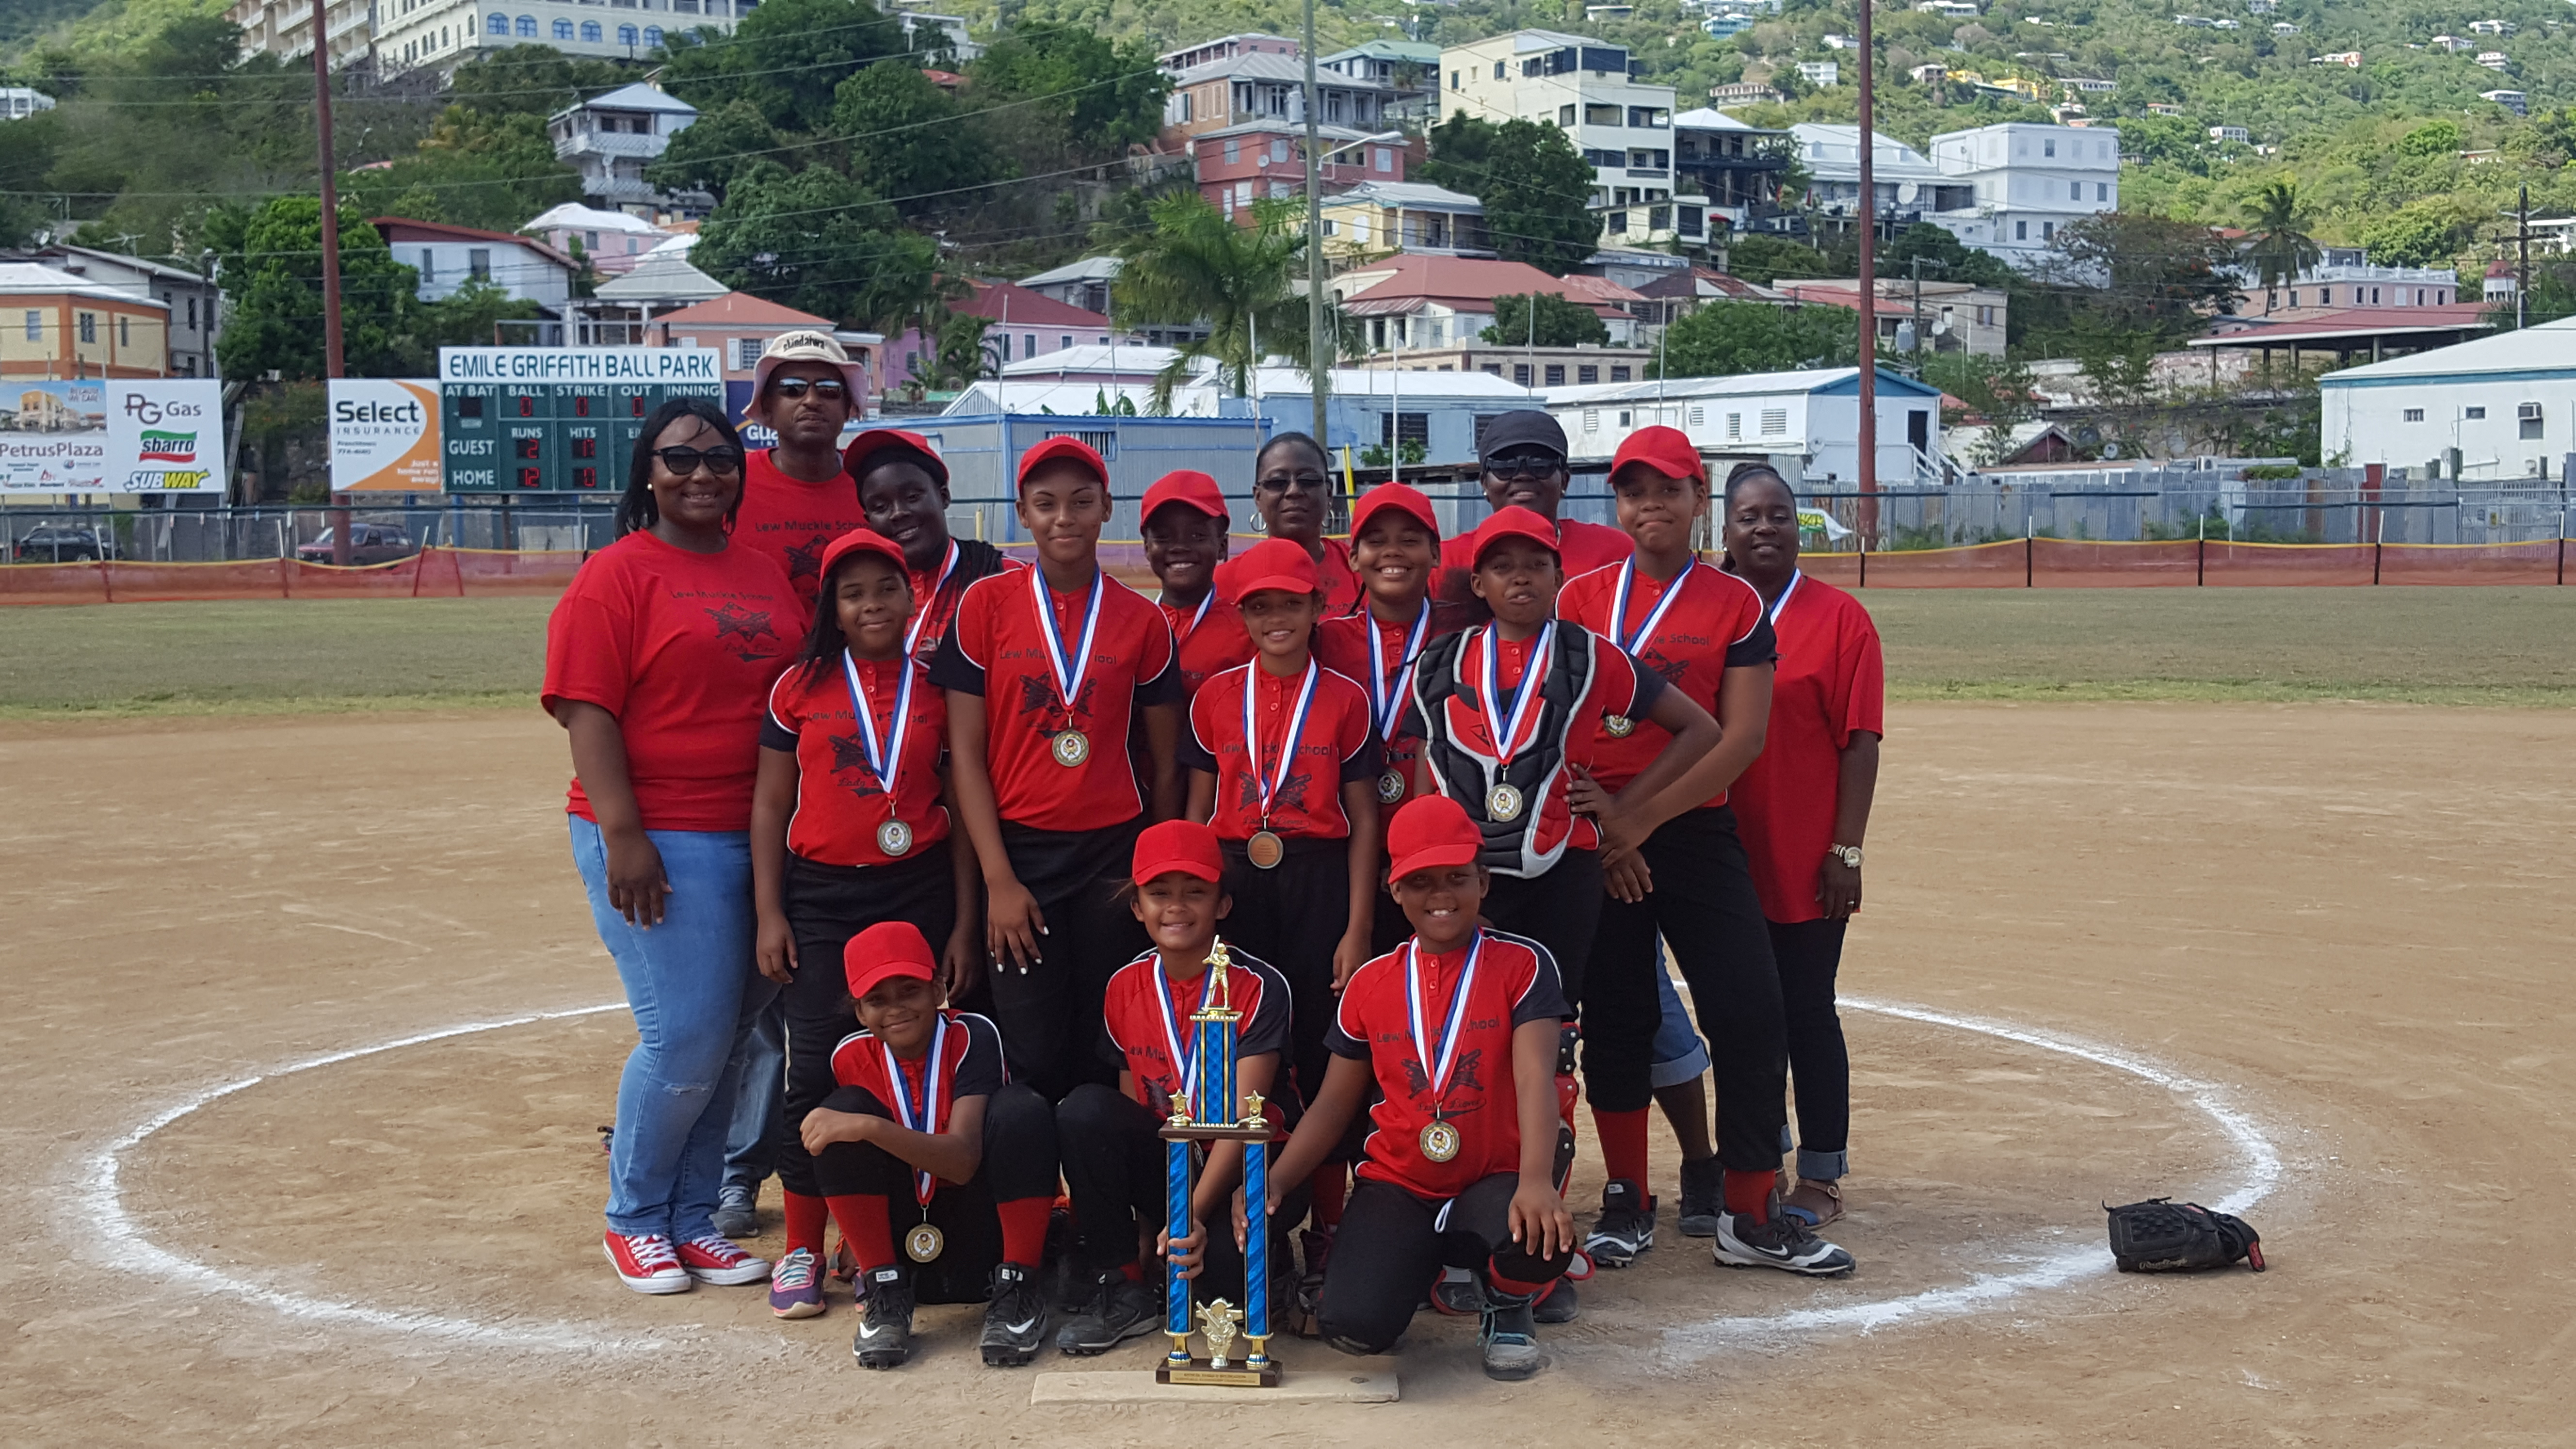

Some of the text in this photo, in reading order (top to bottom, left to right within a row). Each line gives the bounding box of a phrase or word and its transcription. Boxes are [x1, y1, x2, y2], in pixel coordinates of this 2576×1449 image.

[450, 355, 713, 377] EMILE GRIFFITH BALL PARK
[446, 386, 494, 397] AT BAT
[509, 386, 544, 397] BALL
[557, 386, 606, 397] STRIKE
[621, 386, 652, 396] OUT
[667, 386, 719, 396] INNING
[166, 401, 202, 416] Gas
[336, 400, 419, 422] Select
[520, 397, 532, 416] 0
[576, 397, 588, 416] 0
[632, 397, 644, 416] 0
[337, 426, 420, 435] INSURANCE
[511, 428, 543, 438] RUNS
[569, 427, 596, 438] HITS
[142, 438, 194, 452] sbarro
[449, 440, 495, 455] GUEST
[527, 439, 538, 459] 2
[123, 468, 210, 492] SUBWAY
[453, 470, 495, 485] HOME
[525, 467, 540, 487] 12
[584, 467, 596, 487] 0
[756, 522, 780, 532] Lew
[785, 520, 831, 530] Muckle
[1670, 633, 1709, 645] School
[1300, 743, 1332, 756] chool
